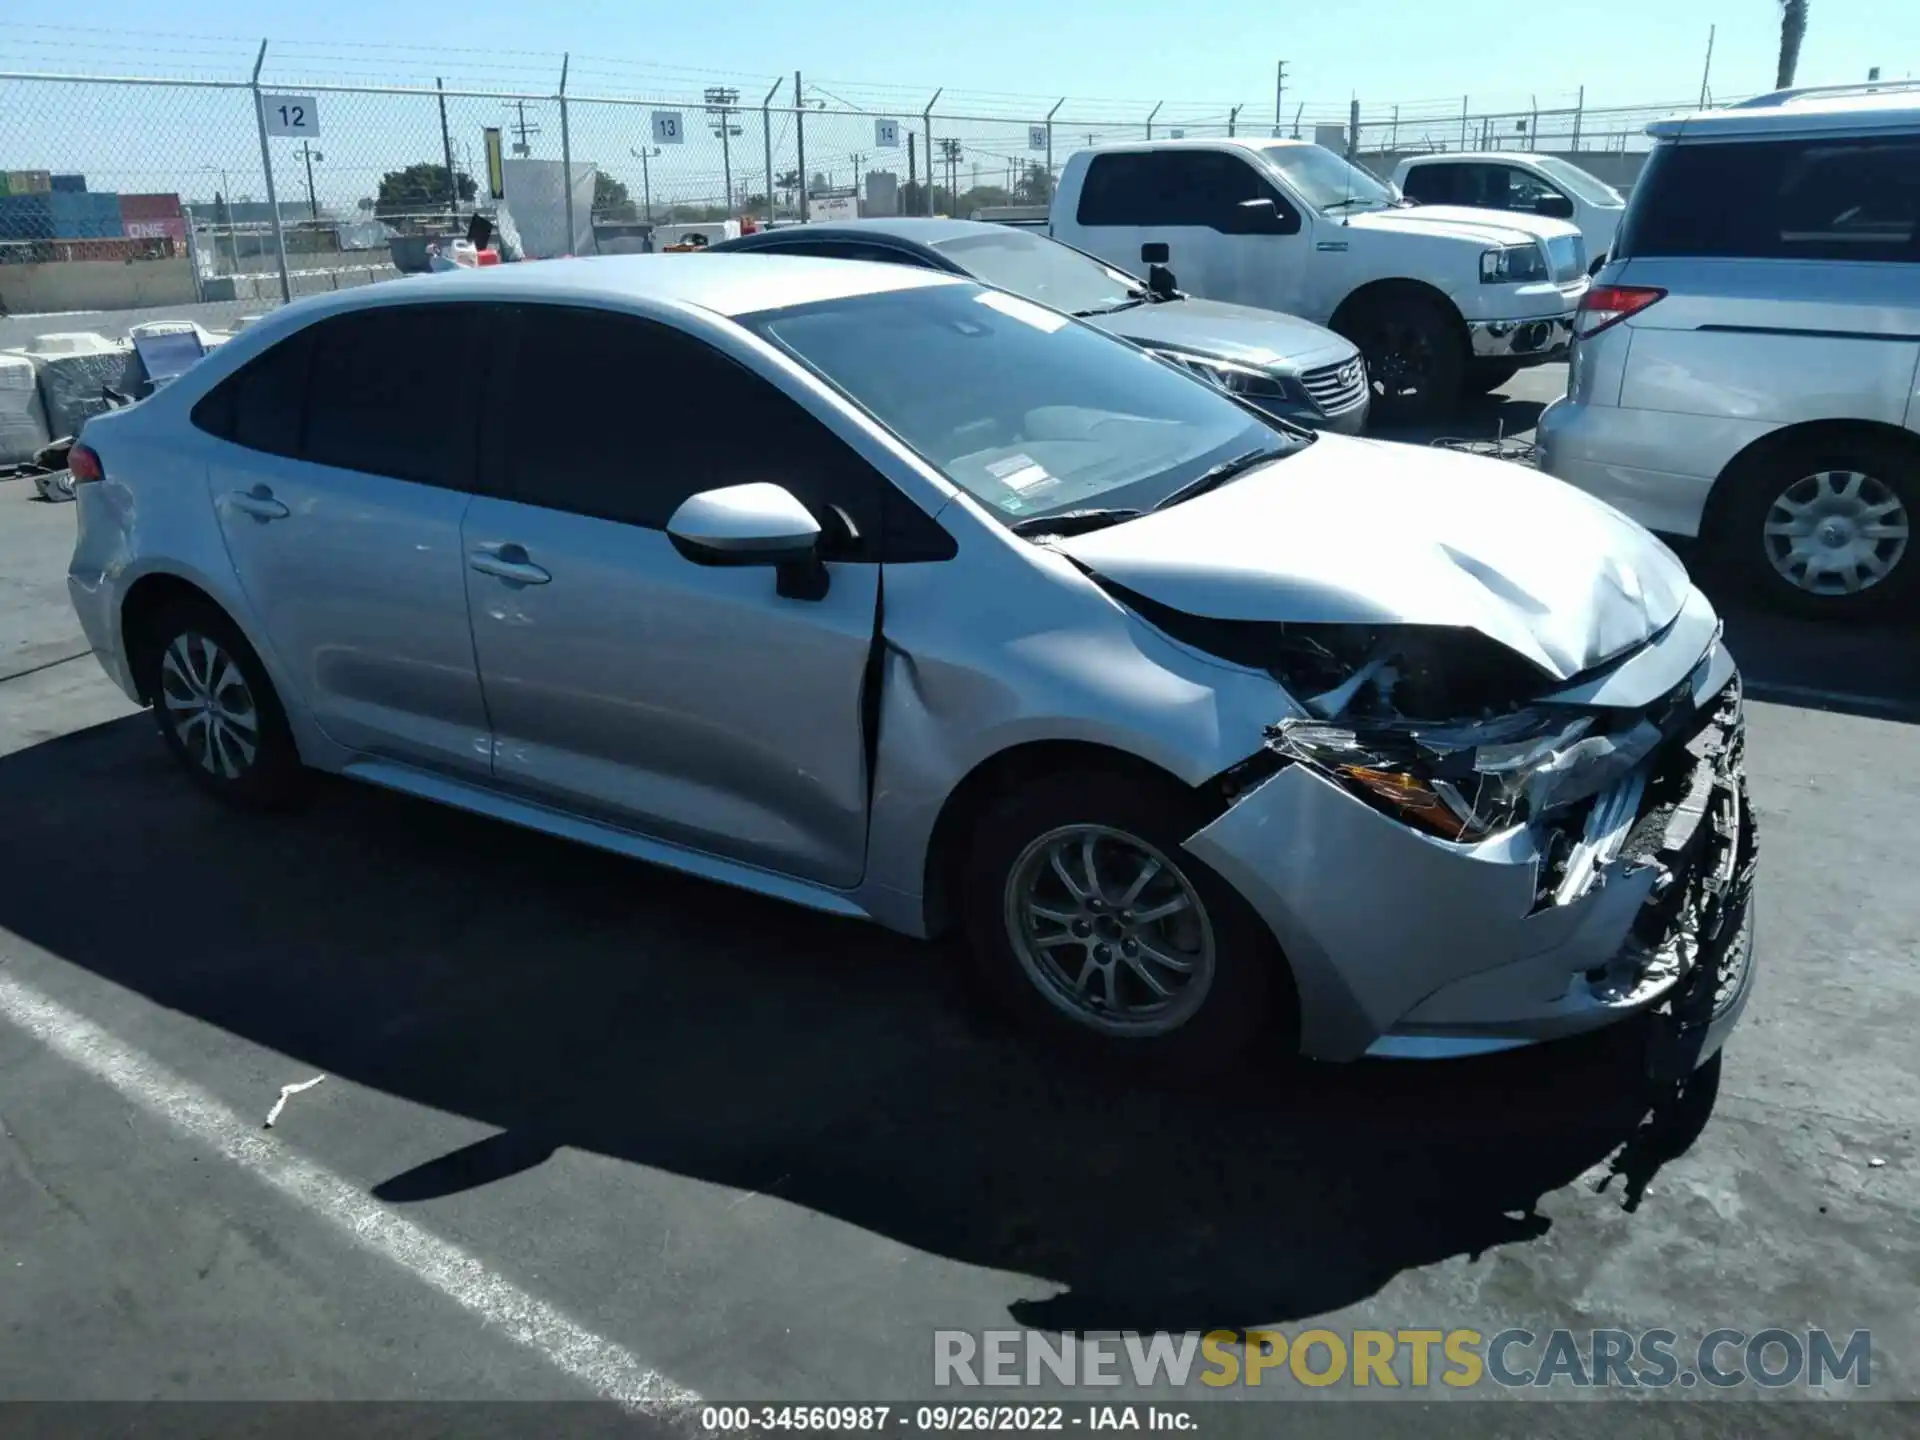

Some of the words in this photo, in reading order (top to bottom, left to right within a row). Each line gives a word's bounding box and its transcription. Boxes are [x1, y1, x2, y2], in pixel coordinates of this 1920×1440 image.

[277, 105, 306, 127] 12
[660, 119, 676, 137] 13
[880, 127, 893, 141] 14
